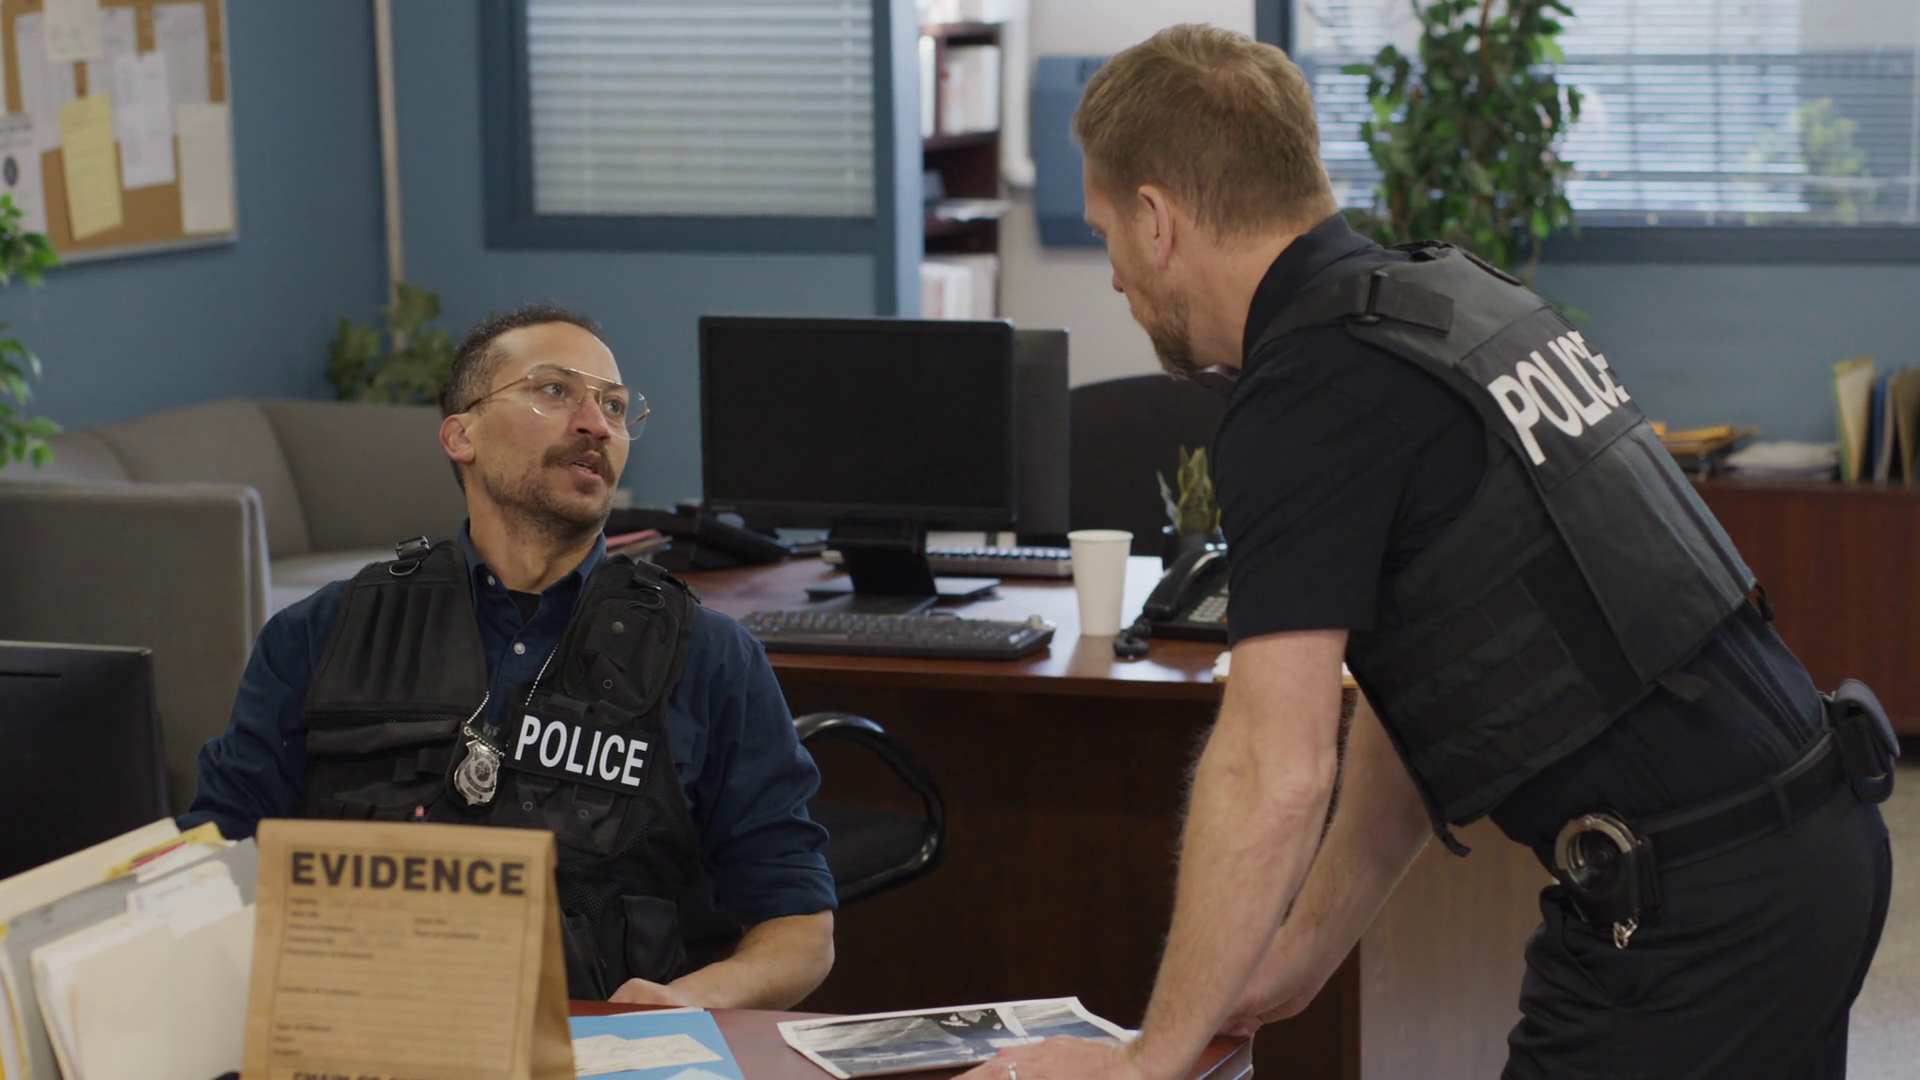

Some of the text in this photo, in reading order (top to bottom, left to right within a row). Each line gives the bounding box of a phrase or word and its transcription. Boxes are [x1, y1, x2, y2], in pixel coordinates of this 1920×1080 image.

[1486, 330, 1631, 466] POLICE
[514, 714, 649, 787] POLICE
[291, 851, 525, 896] EVIDENCE
